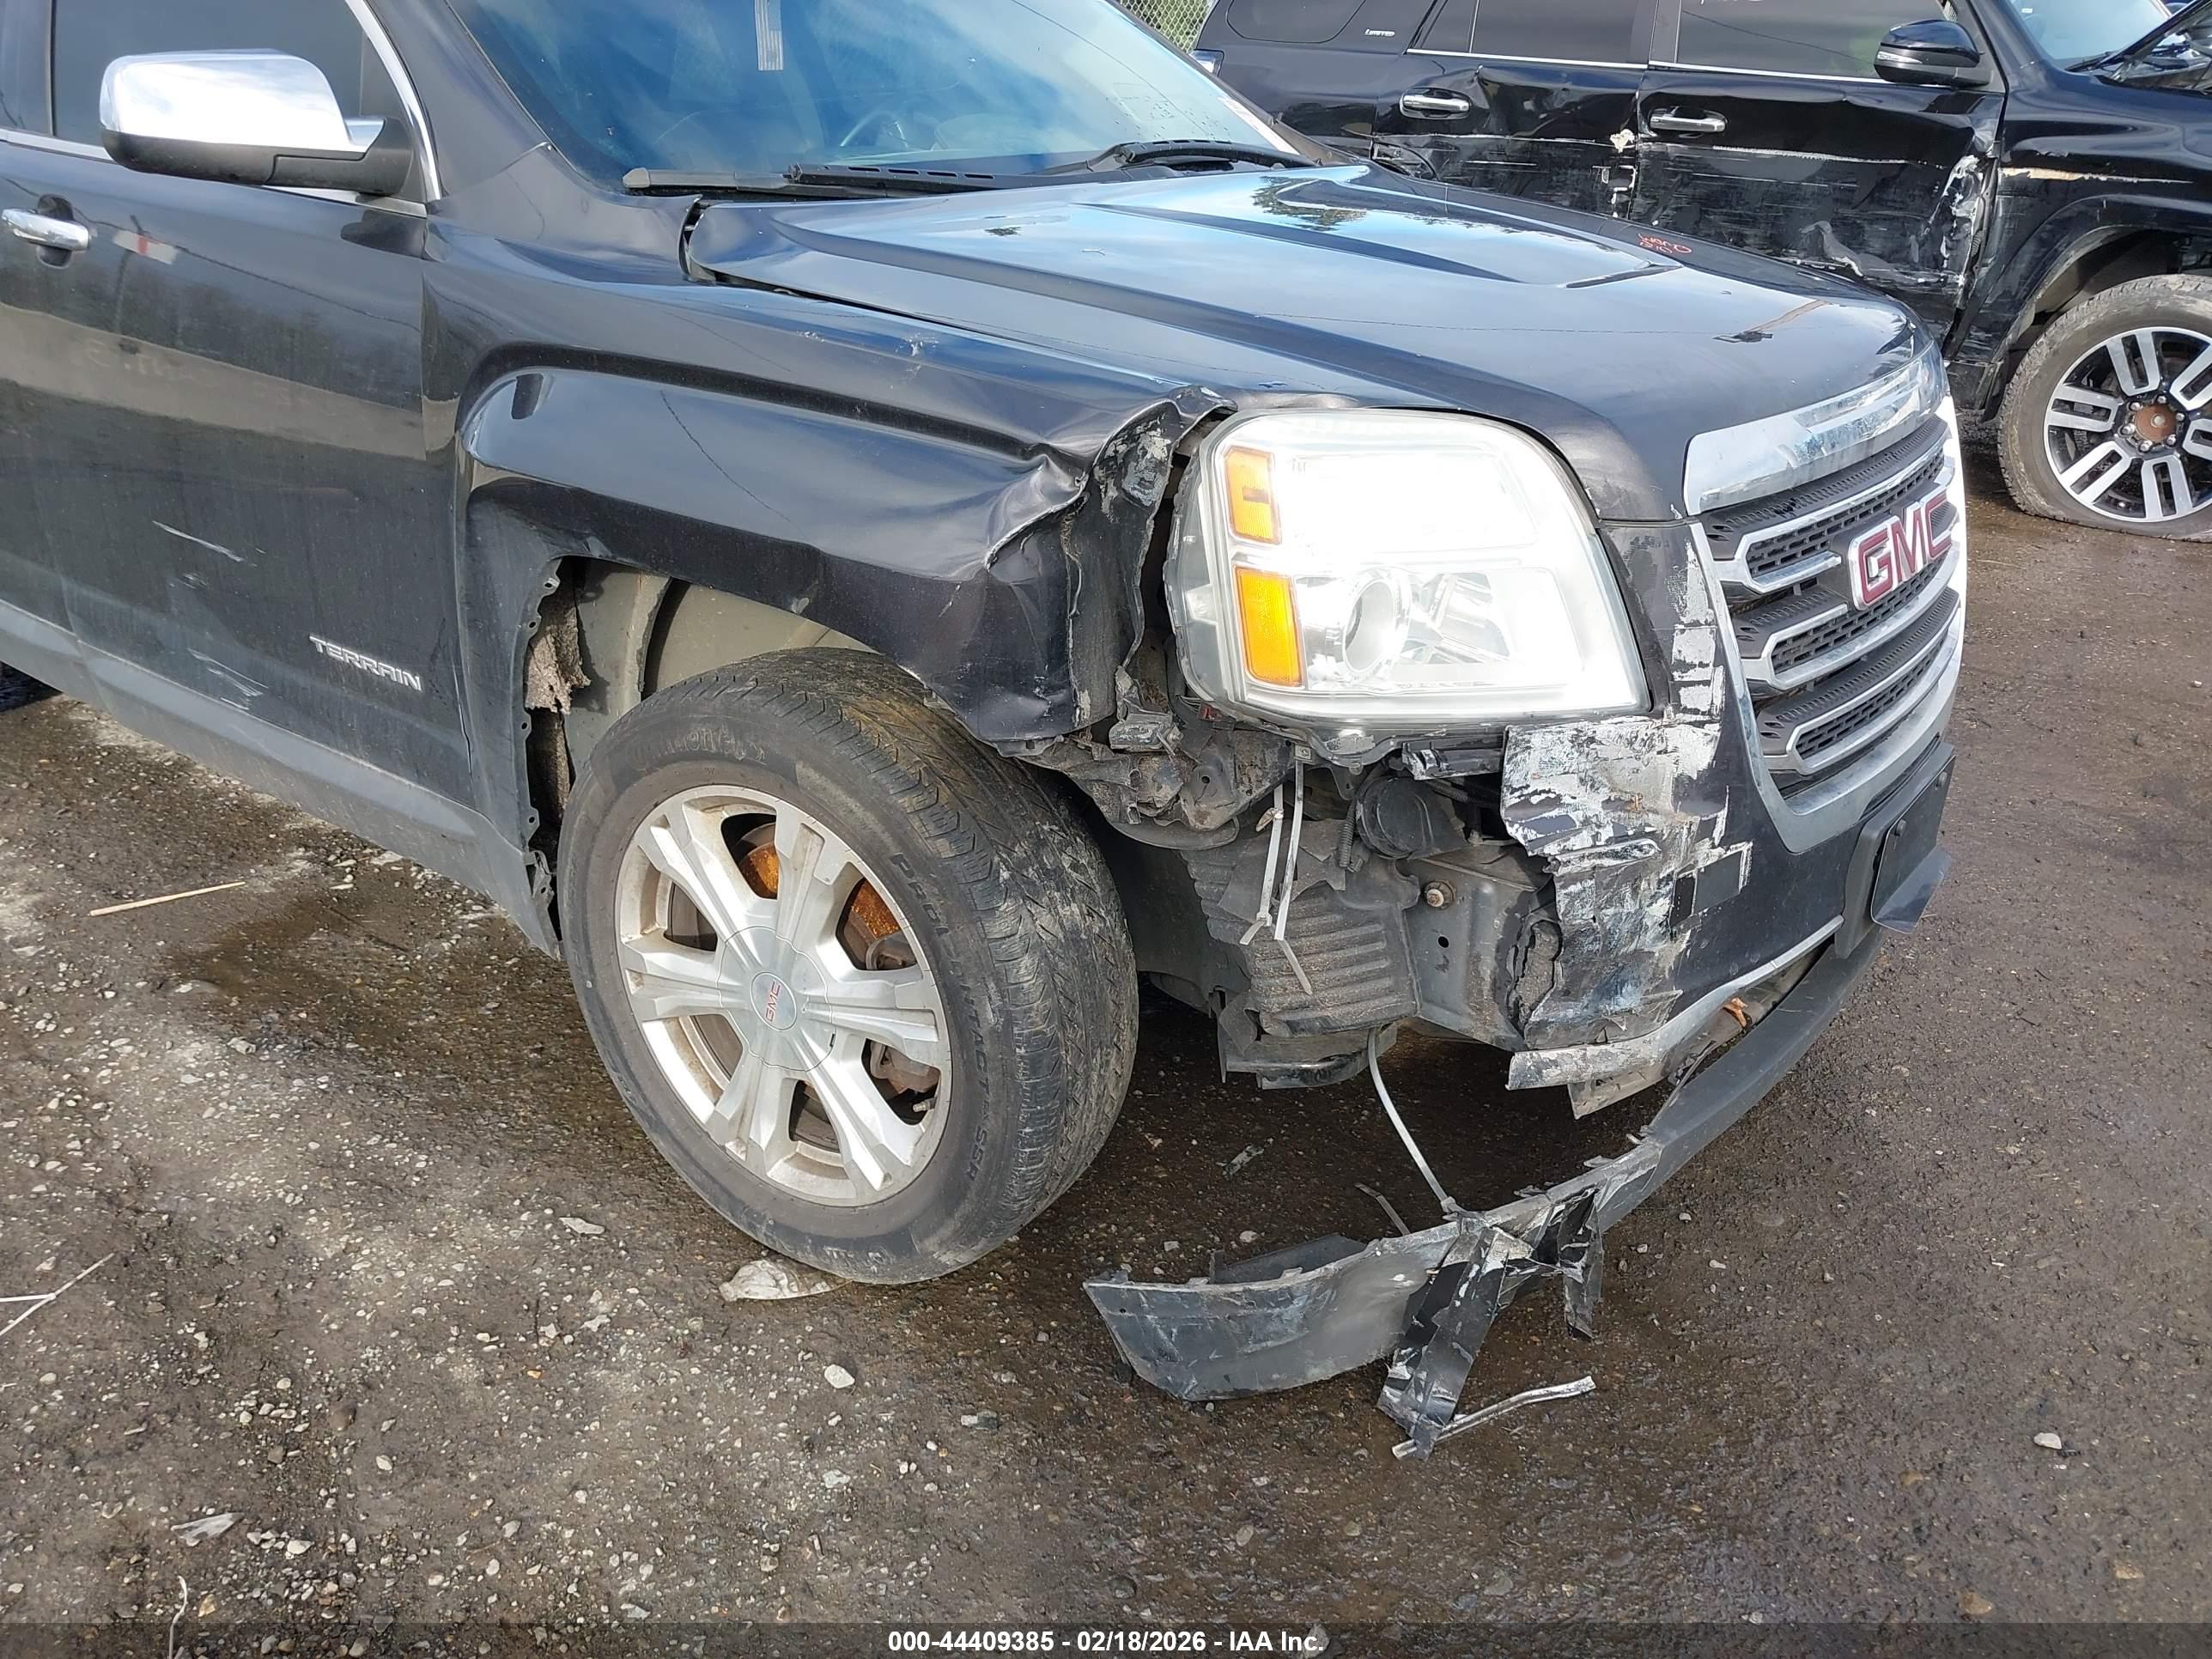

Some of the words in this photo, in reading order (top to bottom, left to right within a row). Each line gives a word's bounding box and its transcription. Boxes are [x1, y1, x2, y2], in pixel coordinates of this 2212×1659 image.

[1850, 489, 1953, 608] GMC
[309, 635, 422, 691] TERRAIN
[765, 981, 781, 1023] GMC
